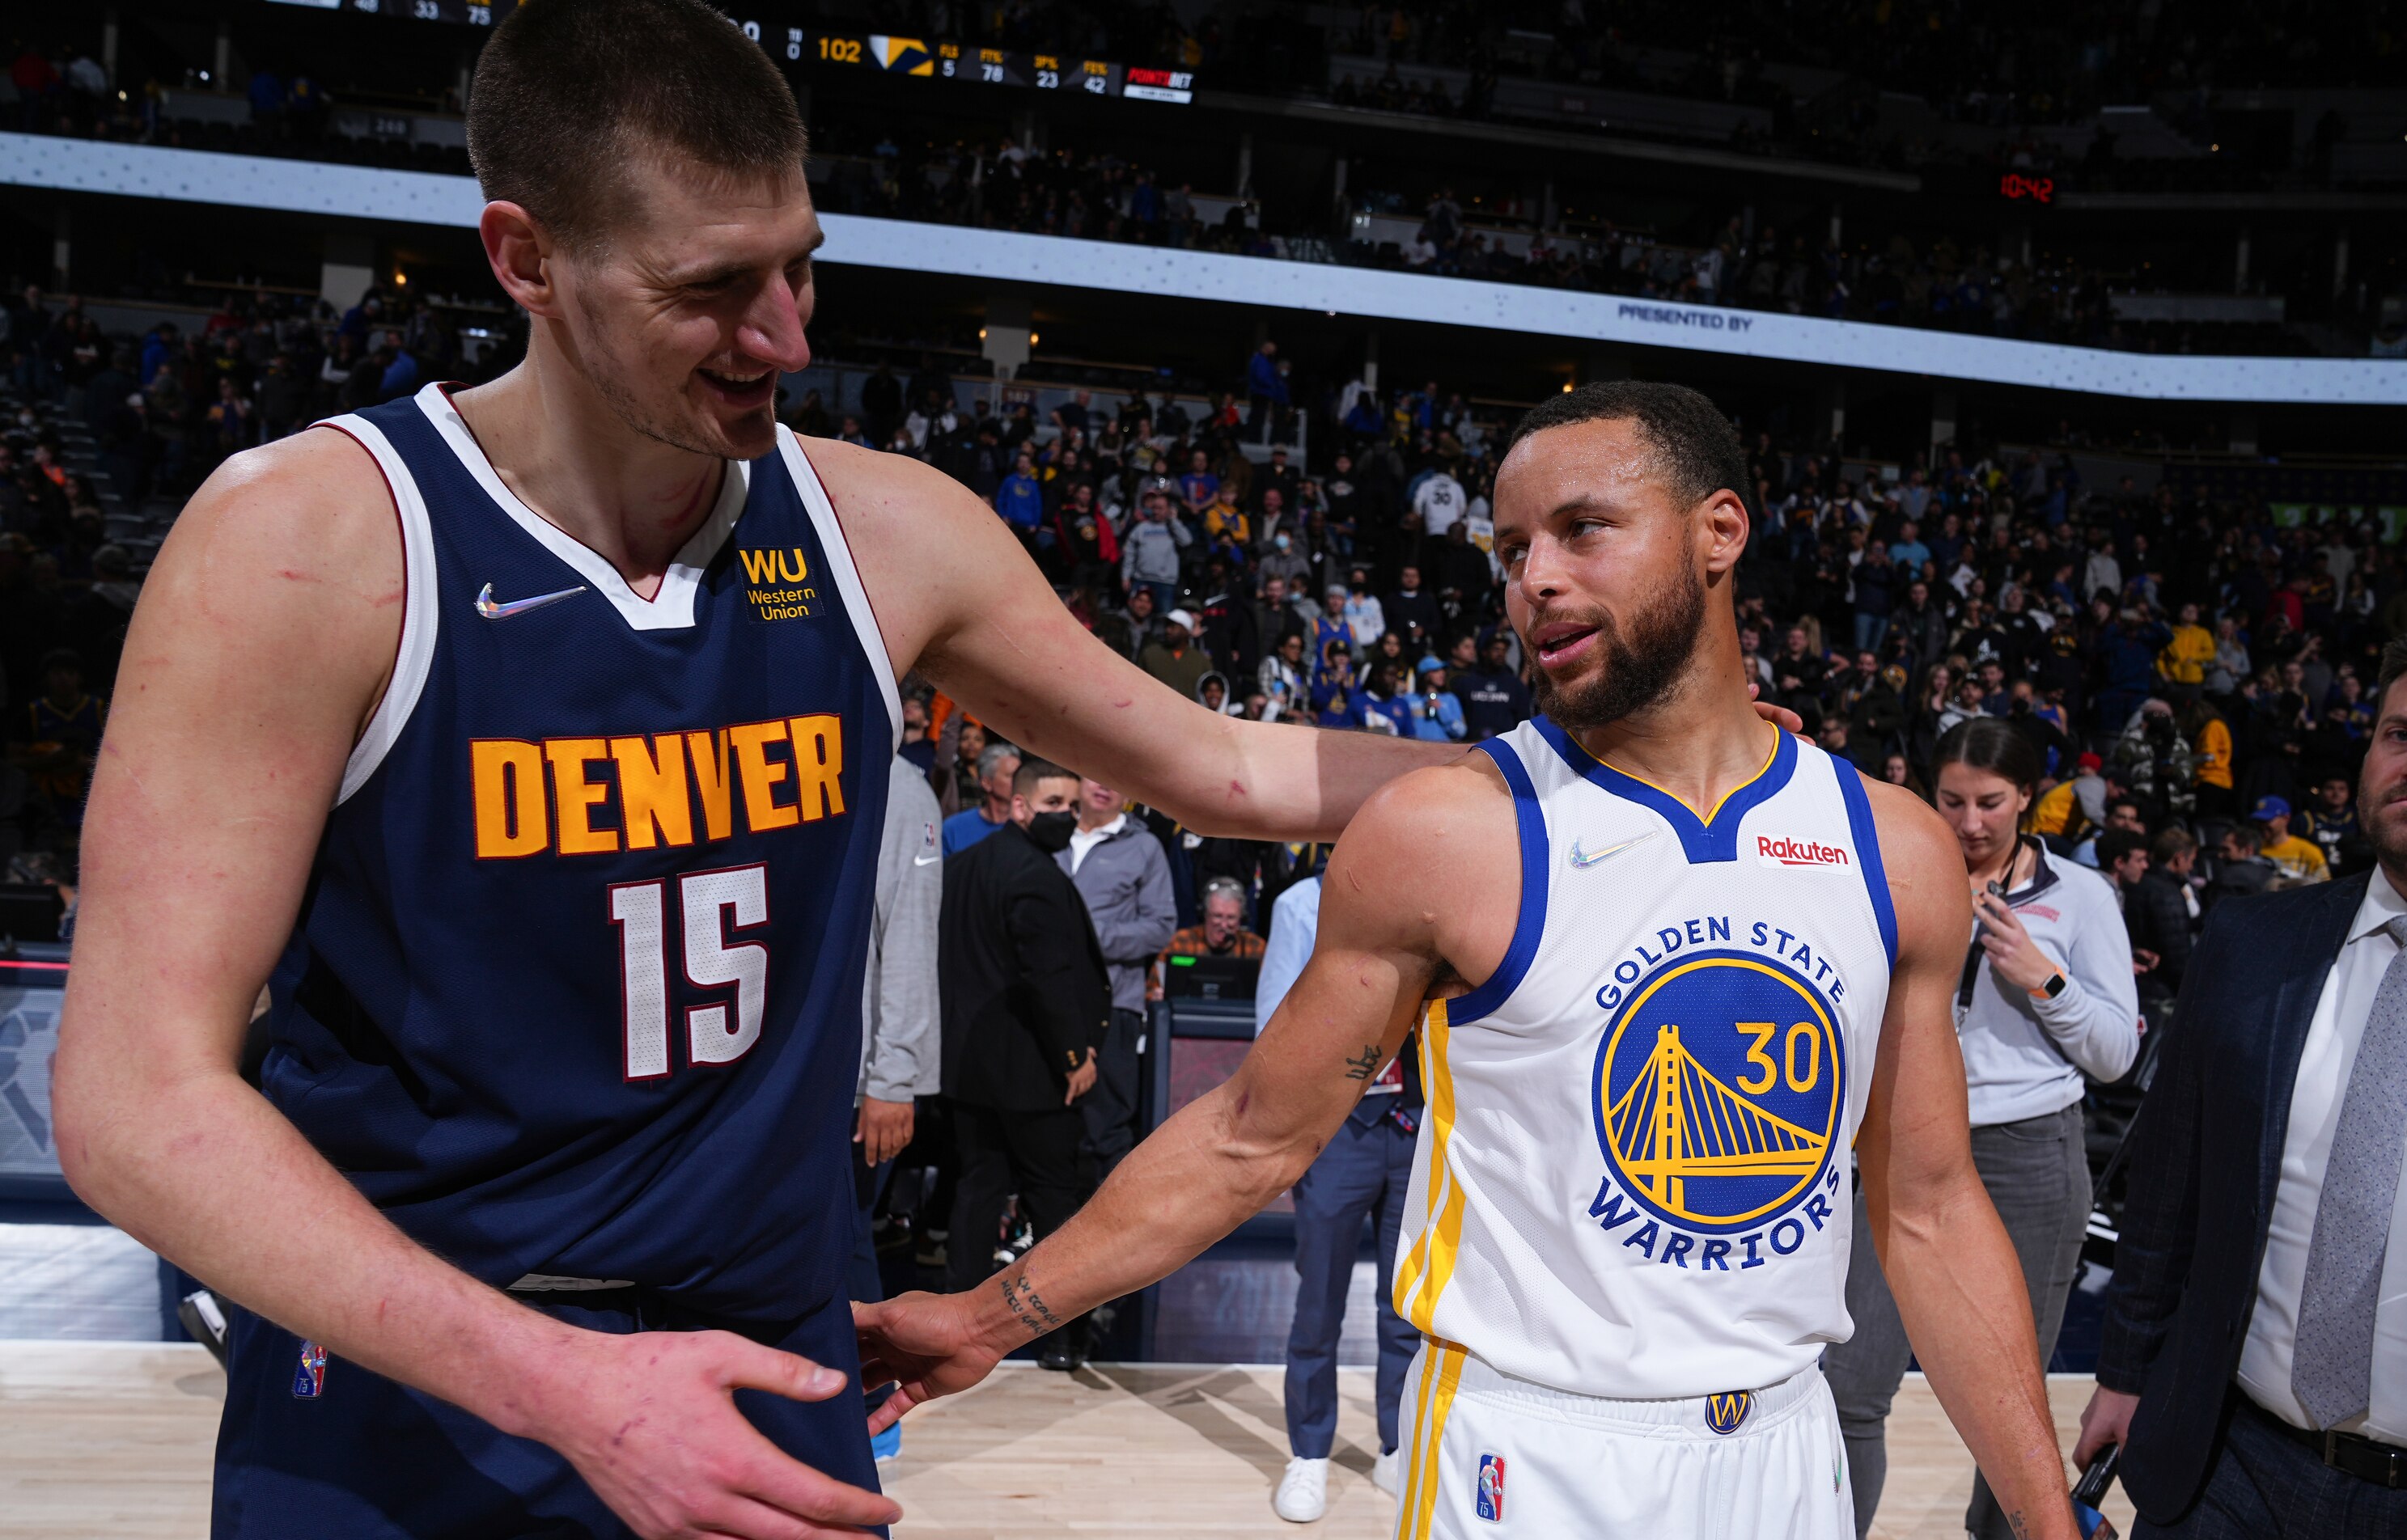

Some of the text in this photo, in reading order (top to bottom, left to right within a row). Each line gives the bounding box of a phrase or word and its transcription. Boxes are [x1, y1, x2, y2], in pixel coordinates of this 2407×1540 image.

[819, 37, 862, 63] 102
[2001, 174, 2054, 203] 10:42
[1619, 303, 1753, 332] PRESENTED BY
[739, 548, 807, 584] WU
[747, 588, 816, 604] Western
[761, 604, 810, 620] Union
[468, 712, 847, 860] DENVER
[1757, 836, 1849, 865] Rakuten
[607, 861, 770, 1084] 15
[1595, 916, 1845, 1010] GOLDEN STATE
[1735, 1022, 1821, 1095] 30
[1587, 1165, 1841, 1271] WARRIORS
[1479, 1501, 1490, 1517] 75
